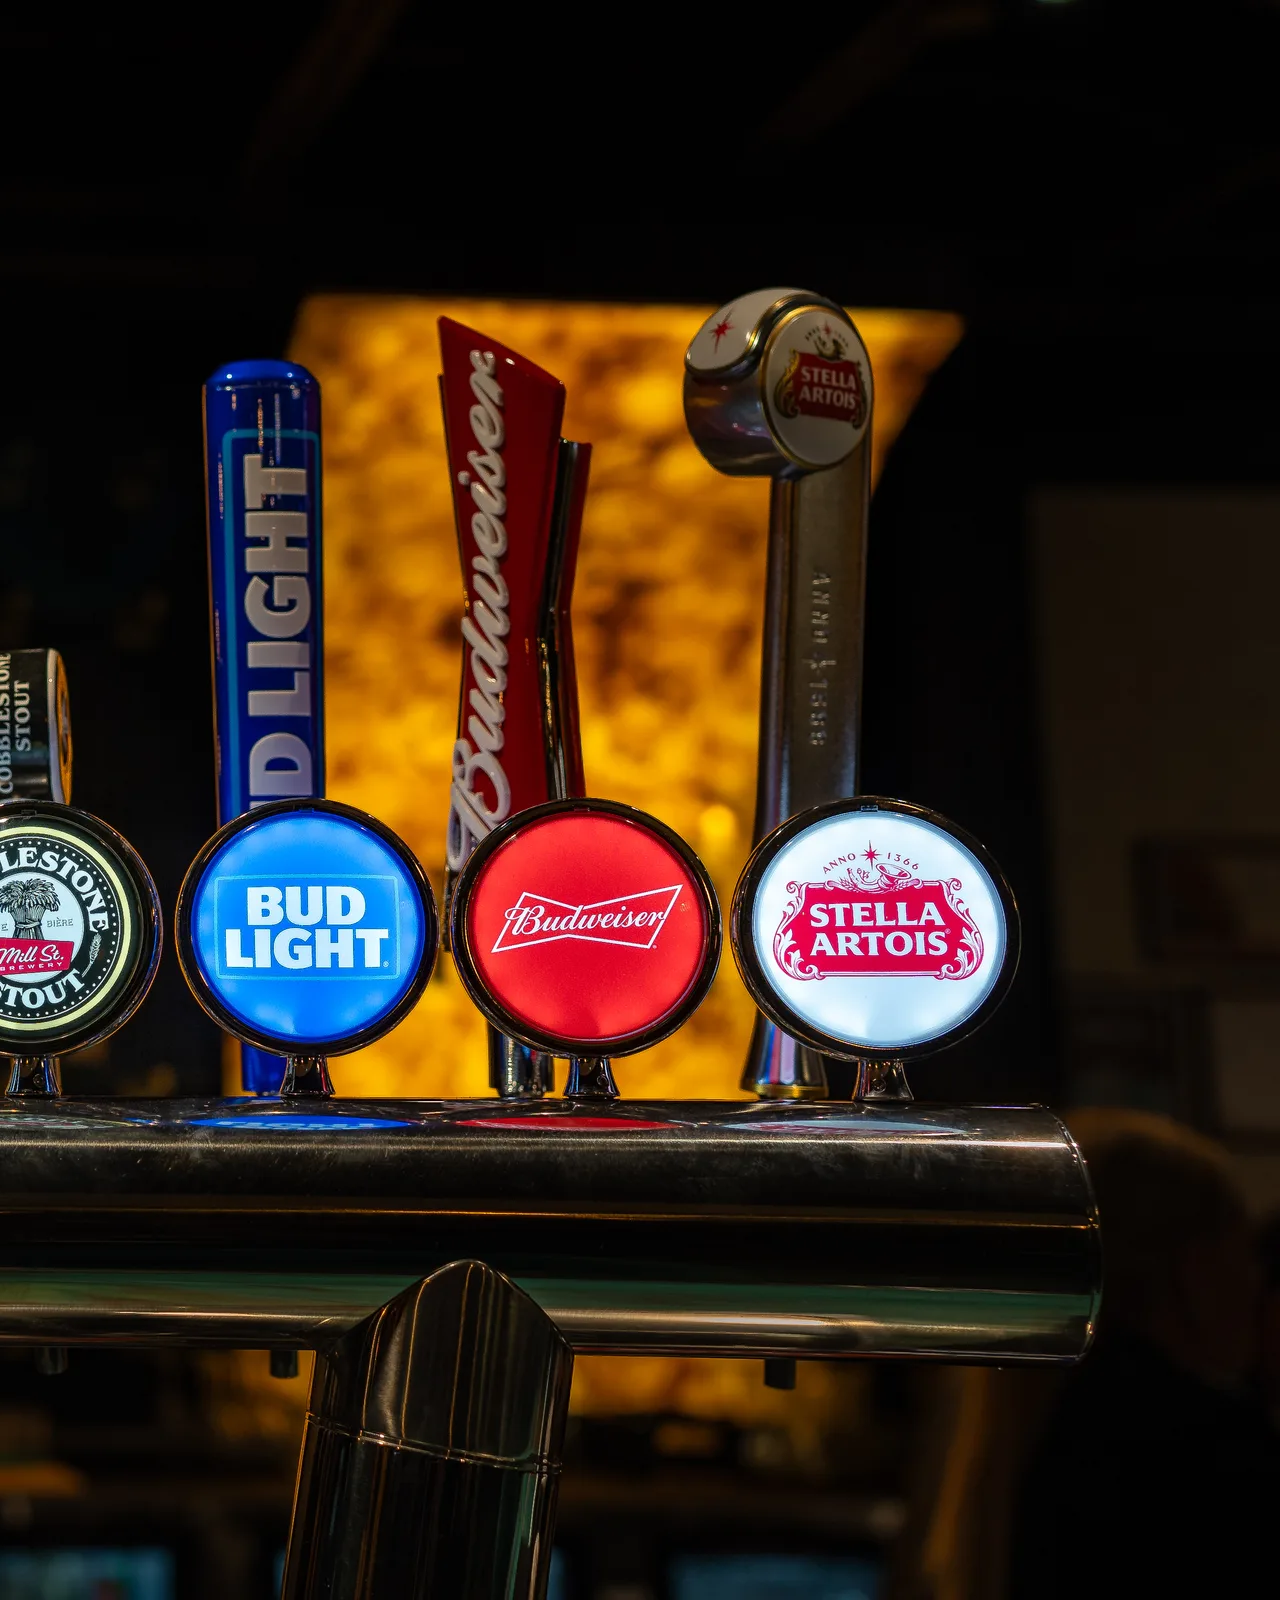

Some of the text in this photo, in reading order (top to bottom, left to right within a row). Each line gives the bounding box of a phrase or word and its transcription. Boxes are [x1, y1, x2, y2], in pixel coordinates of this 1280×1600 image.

[800, 365, 856, 391] STELLA
[798, 384, 856, 410] ARTOIS
[244, 453, 311, 717] LIGHT
[14, 680, 31, 752] STOUT
[822, 852, 919, 875] ANNO 1366
[247, 886, 366, 926] BUD
[809, 901, 946, 928] STELLA
[46, 917, 74, 928] BIÈRE
[504, 905, 666, 936] Budweiser
[40, 944, 64, 962] St.
[225, 928, 389, 969] LIGHT
[809, 931, 949, 957] ARTOIS
[0, 962, 63, 972] BREWERY
